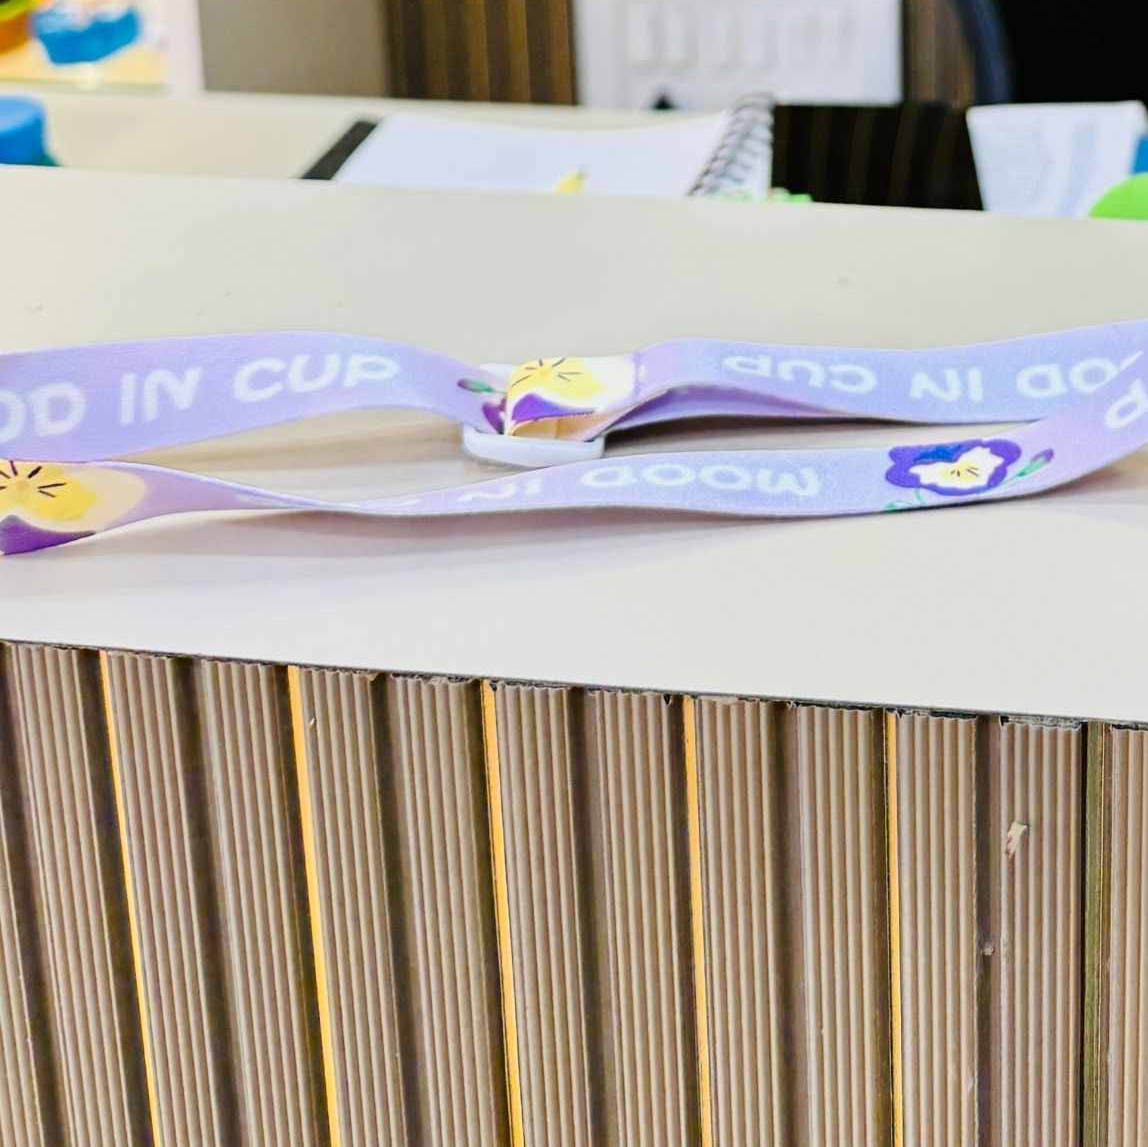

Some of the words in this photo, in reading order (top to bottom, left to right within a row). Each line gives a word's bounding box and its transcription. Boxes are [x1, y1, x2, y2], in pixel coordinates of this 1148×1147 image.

[119, 367, 201, 427] IN
[233, 353, 401, 404] CUP
[722, 354, 879, 395] CUP
[909, 367, 985, 403] IN
[580, 462, 824, 497] MOOD
